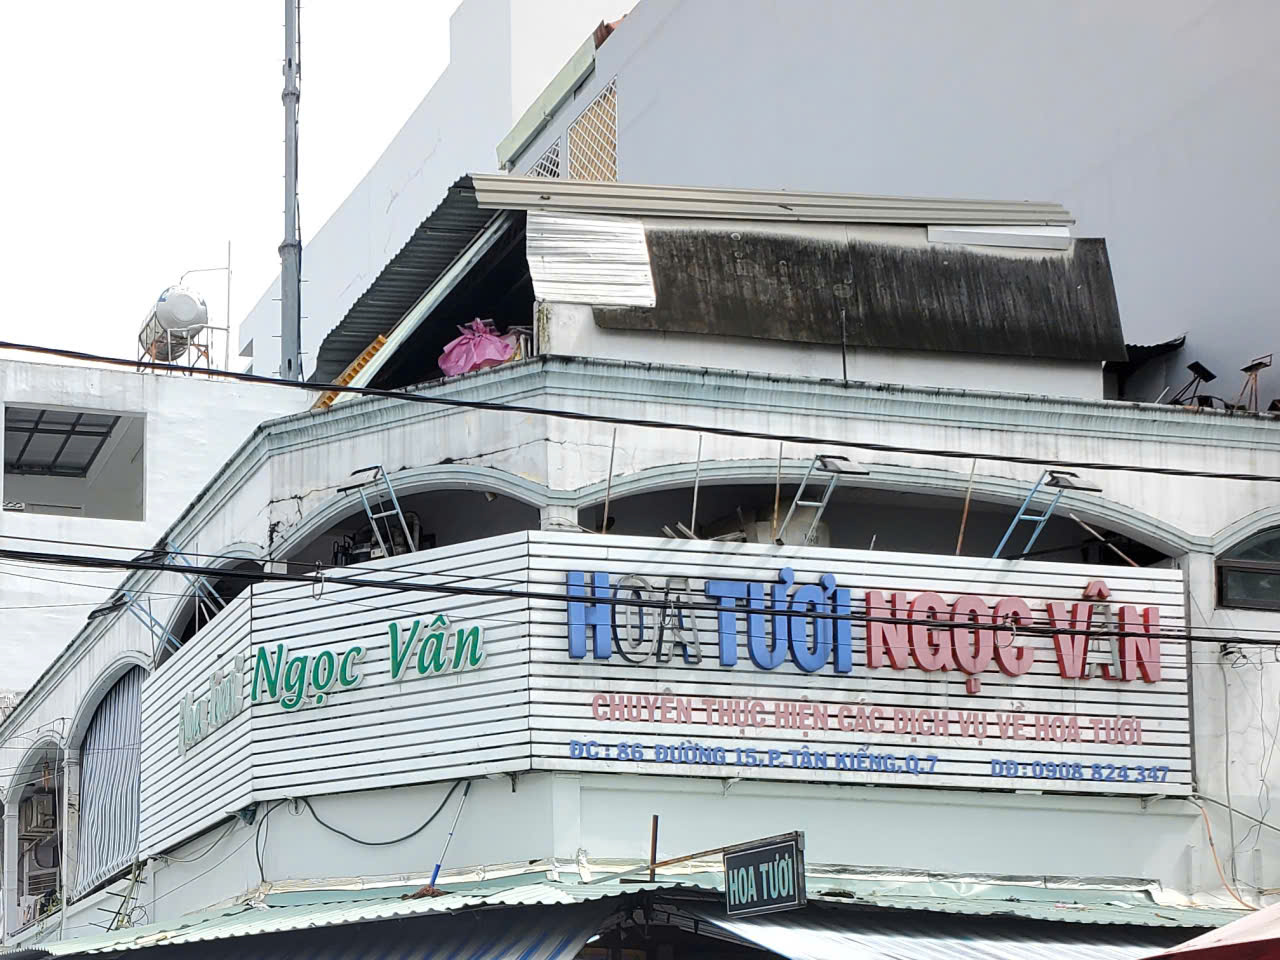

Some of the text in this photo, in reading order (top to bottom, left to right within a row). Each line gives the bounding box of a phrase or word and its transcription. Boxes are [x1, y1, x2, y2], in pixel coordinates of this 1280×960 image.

[566, 567, 1162, 694] HOA TƯƠI NGỌC VÂN
[251, 642, 366, 712] Ngọc
[387, 614, 486, 682] Vân
[592, 687, 692, 725] CHUYÊN
[702, 695, 767, 735] THỰC
[775, 695, 828, 738] HIỆN
[837, 697, 885, 733] CÁC
[893, 707, 949, 742] DỊCH
[958, 711, 988, 746] VỤ
[1034, 714, 1081, 743] HOA
[1089, 714, 1143, 745] TƯƠI
[616, 742, 644, 761] 86
[655, 740, 727, 765] ĐƯỜNG
[789, 745, 827, 769] TÂN
[1091, 763, 1130, 783] 824
[1134, 766, 1170, 784] 347
[728, 853, 794, 905] HOA TƯƠI
